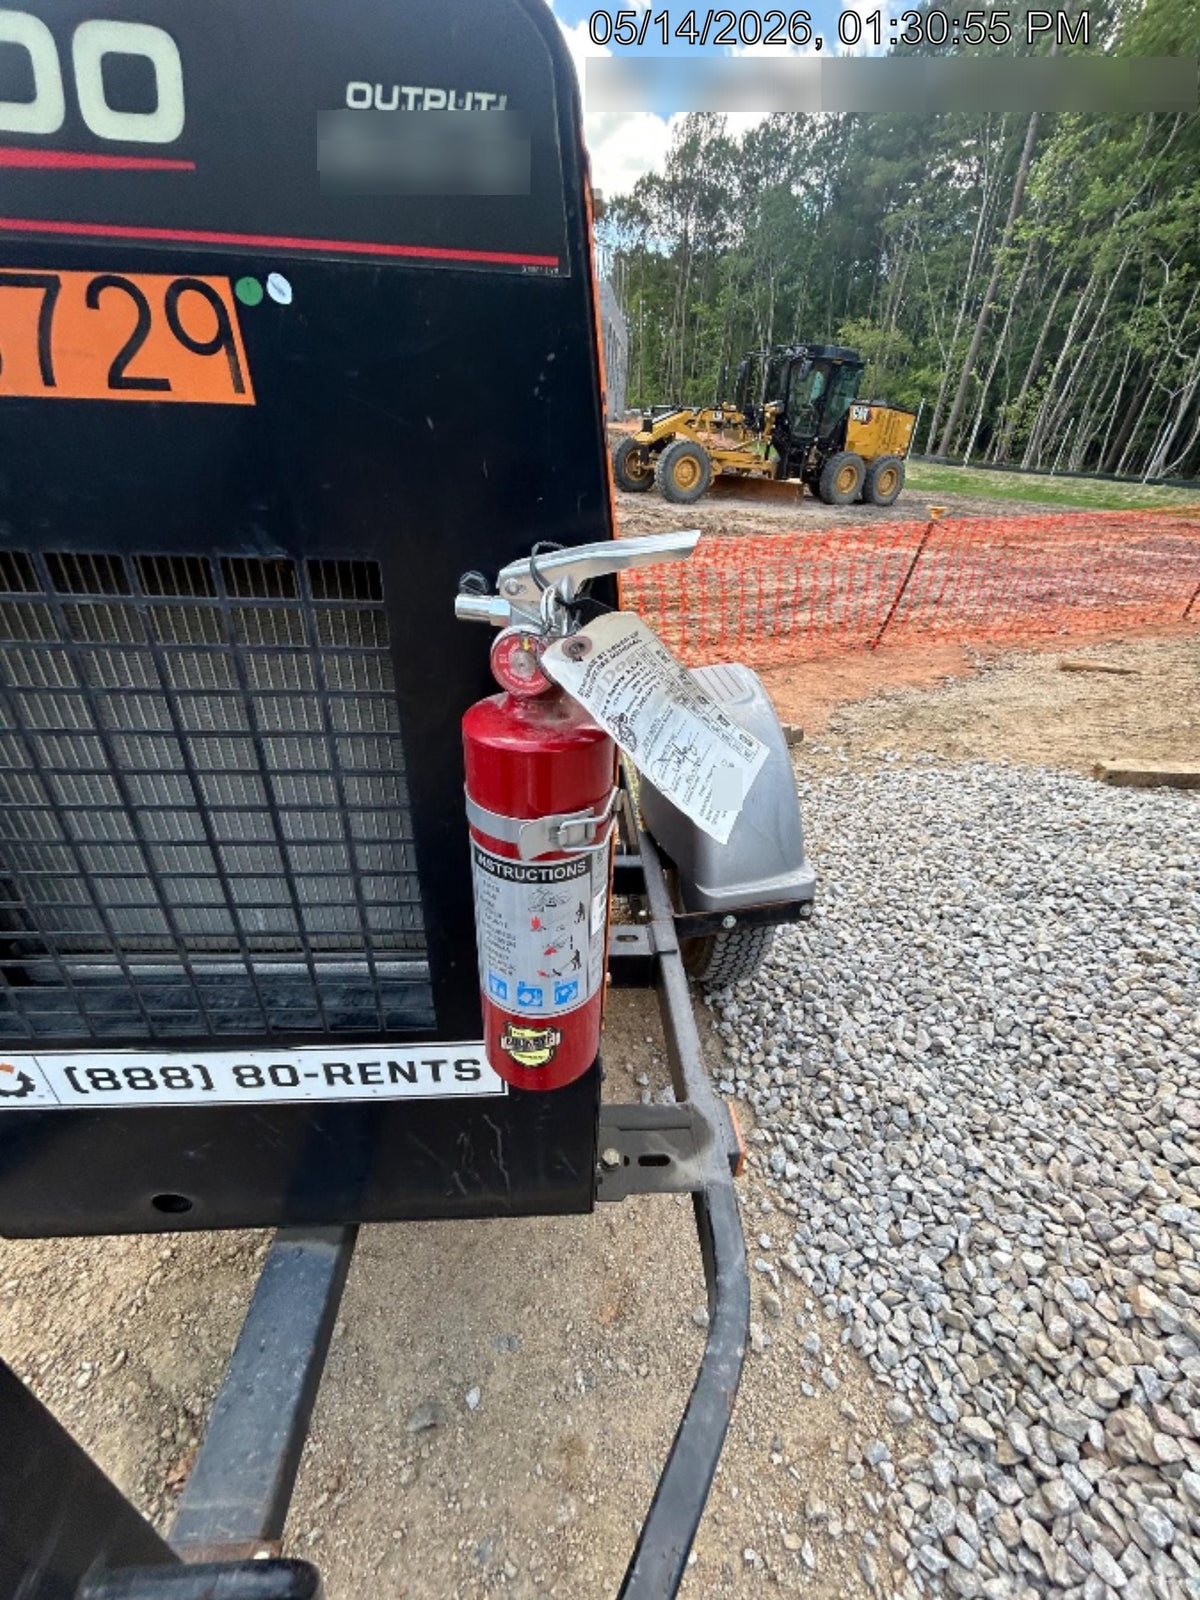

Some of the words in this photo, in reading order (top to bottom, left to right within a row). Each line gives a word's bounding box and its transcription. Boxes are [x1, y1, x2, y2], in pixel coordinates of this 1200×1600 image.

[346, 81, 497, 111] OUTPUT
[0, 273, 246, 394] 729
[64, 1064, 214, 1094] (888)
[232, 1058, 482, 1089] 80-RENTS
